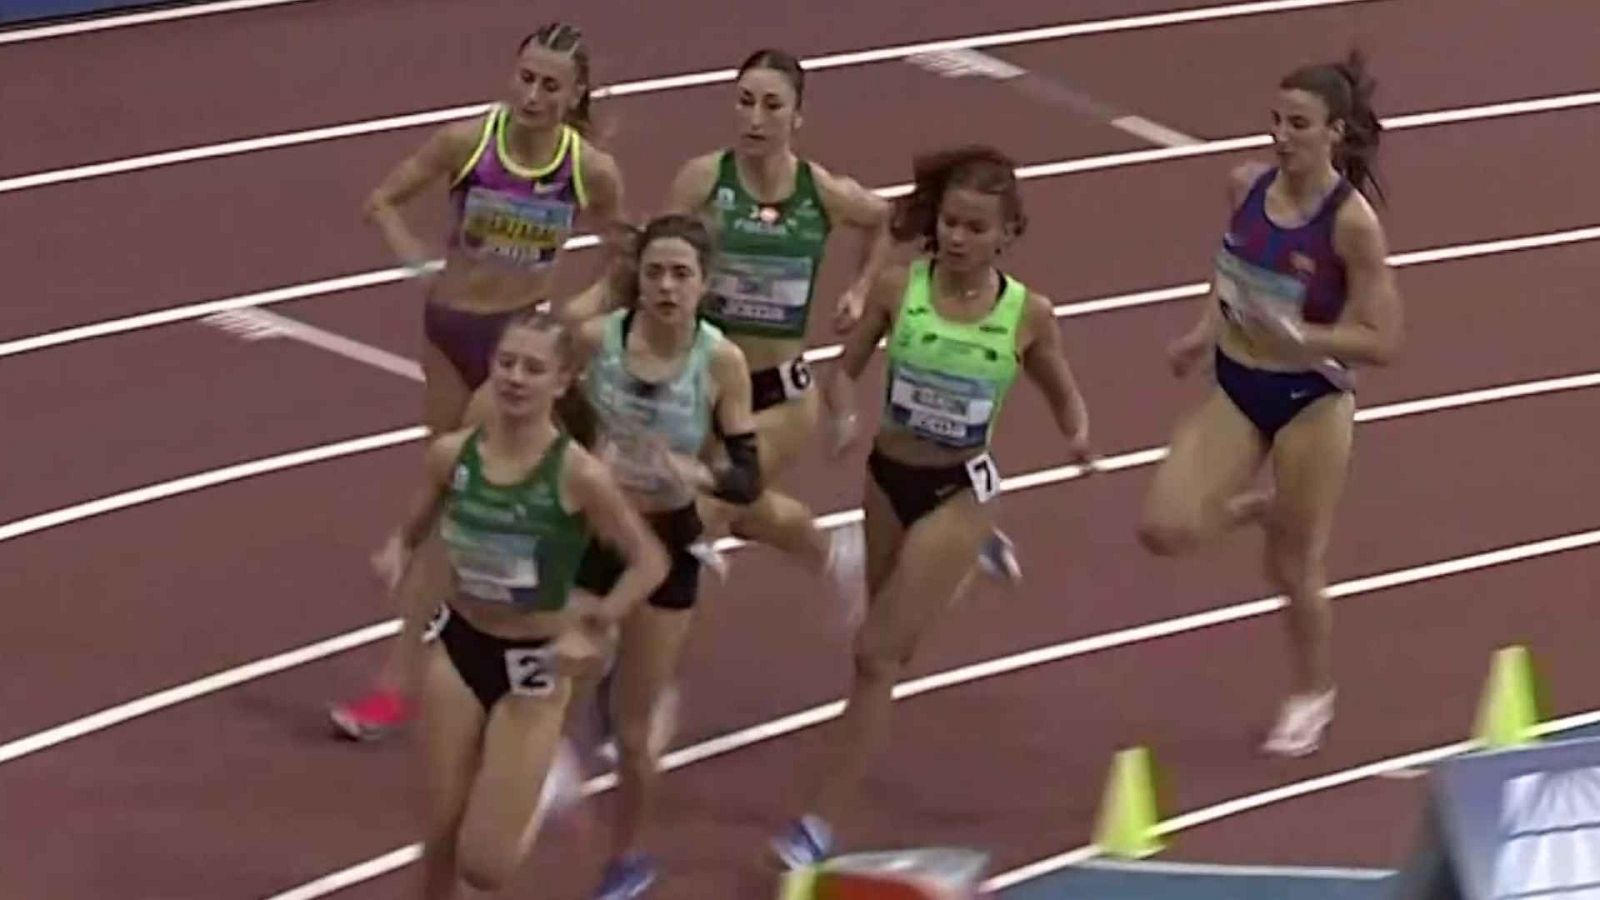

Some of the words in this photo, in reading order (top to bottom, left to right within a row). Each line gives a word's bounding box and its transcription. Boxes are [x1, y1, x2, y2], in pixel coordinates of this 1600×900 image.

[790, 355, 811, 390] 6
[973, 459, 992, 492] 7
[518, 655, 547, 689] 2
